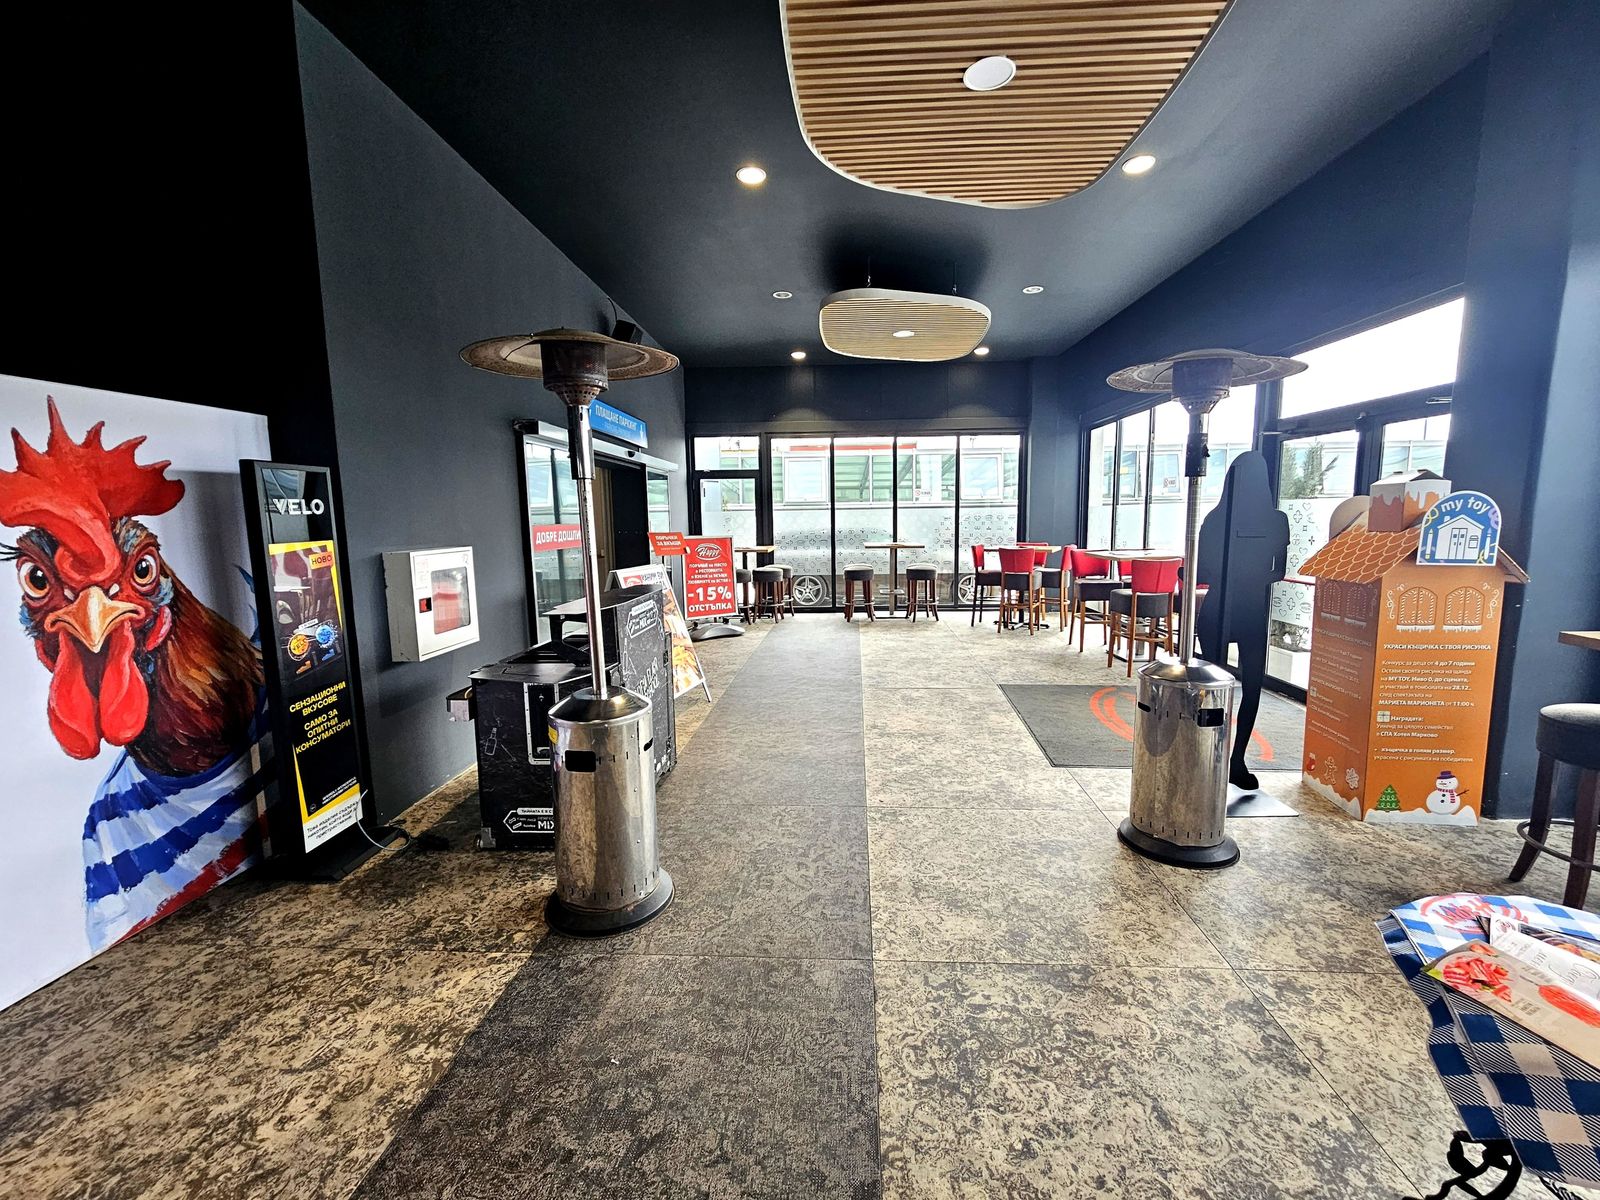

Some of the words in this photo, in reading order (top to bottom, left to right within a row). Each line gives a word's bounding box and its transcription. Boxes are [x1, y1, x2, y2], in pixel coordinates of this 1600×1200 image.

[595, 404, 619, 424] ПЛАЩАНЕ
[272, 498, 324, 515] VELO
[1441, 499, 1463, 512] my
[1468, 496, 1491, 514] toy
[536, 530, 558, 545] ДОБРЕ
[311, 554, 332, 565] НОВО
[688, 586, 731, 601] -15%
[688, 602, 732, 612] ОТСТЪПКА
[289, 680, 346, 713] СЕНЗАЦИОННИ
[302, 693, 338, 716] ВКУСОВЕ
[304, 713, 328, 731] САМО
[328, 708, 338, 719] ЗА
[307, 717, 338, 738] ОПИТНИ
[295, 719, 351, 754] КОНСУМАТОРИ
